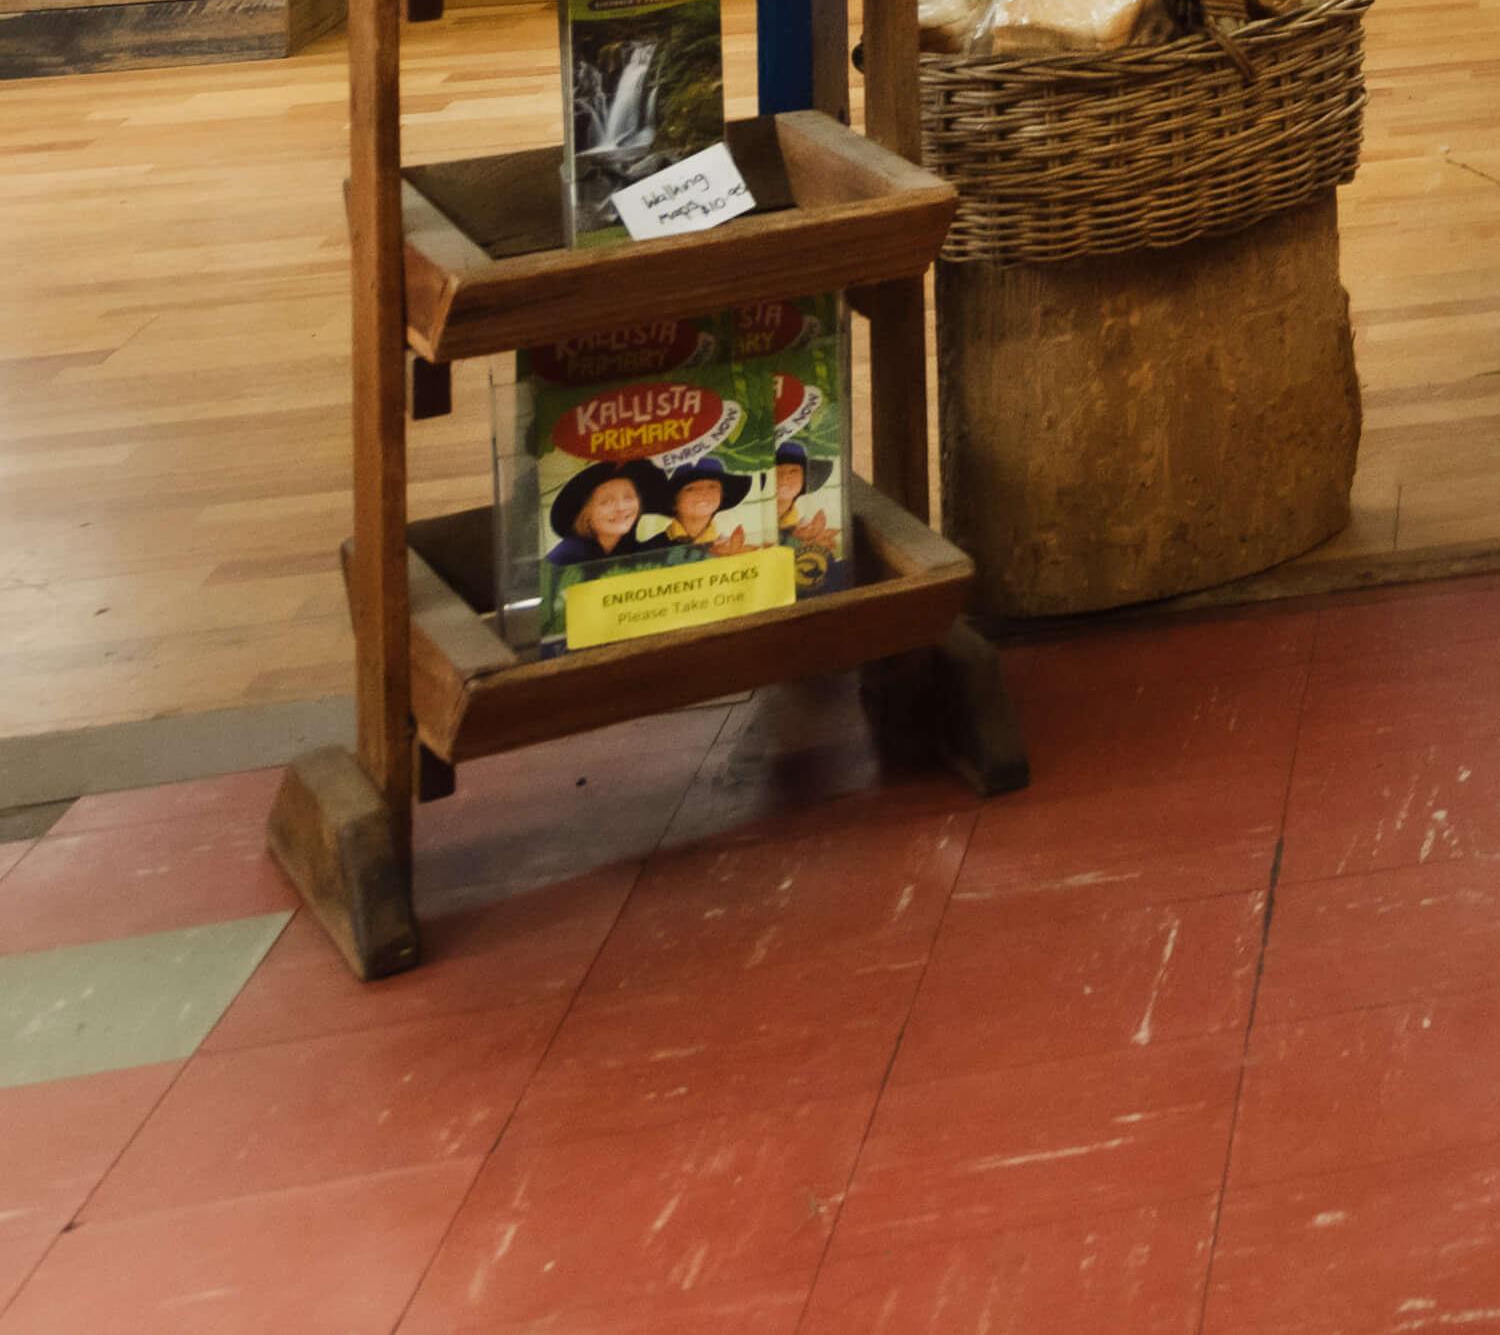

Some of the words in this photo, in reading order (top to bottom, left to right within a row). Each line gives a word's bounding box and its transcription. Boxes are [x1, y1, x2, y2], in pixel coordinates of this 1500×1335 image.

[576, 384, 701, 436] KALLISTA
[590, 417, 693, 453] PRIMARY
[662, 439, 711, 467] ENROL
[711, 406, 739, 441] NOW
[602, 576, 706, 608] ENROLMENT
[708, 565, 760, 588] PACKS
[617, 604, 669, 626] Please
[671, 596, 709, 616] Take
[713, 589, 746, 609] One
